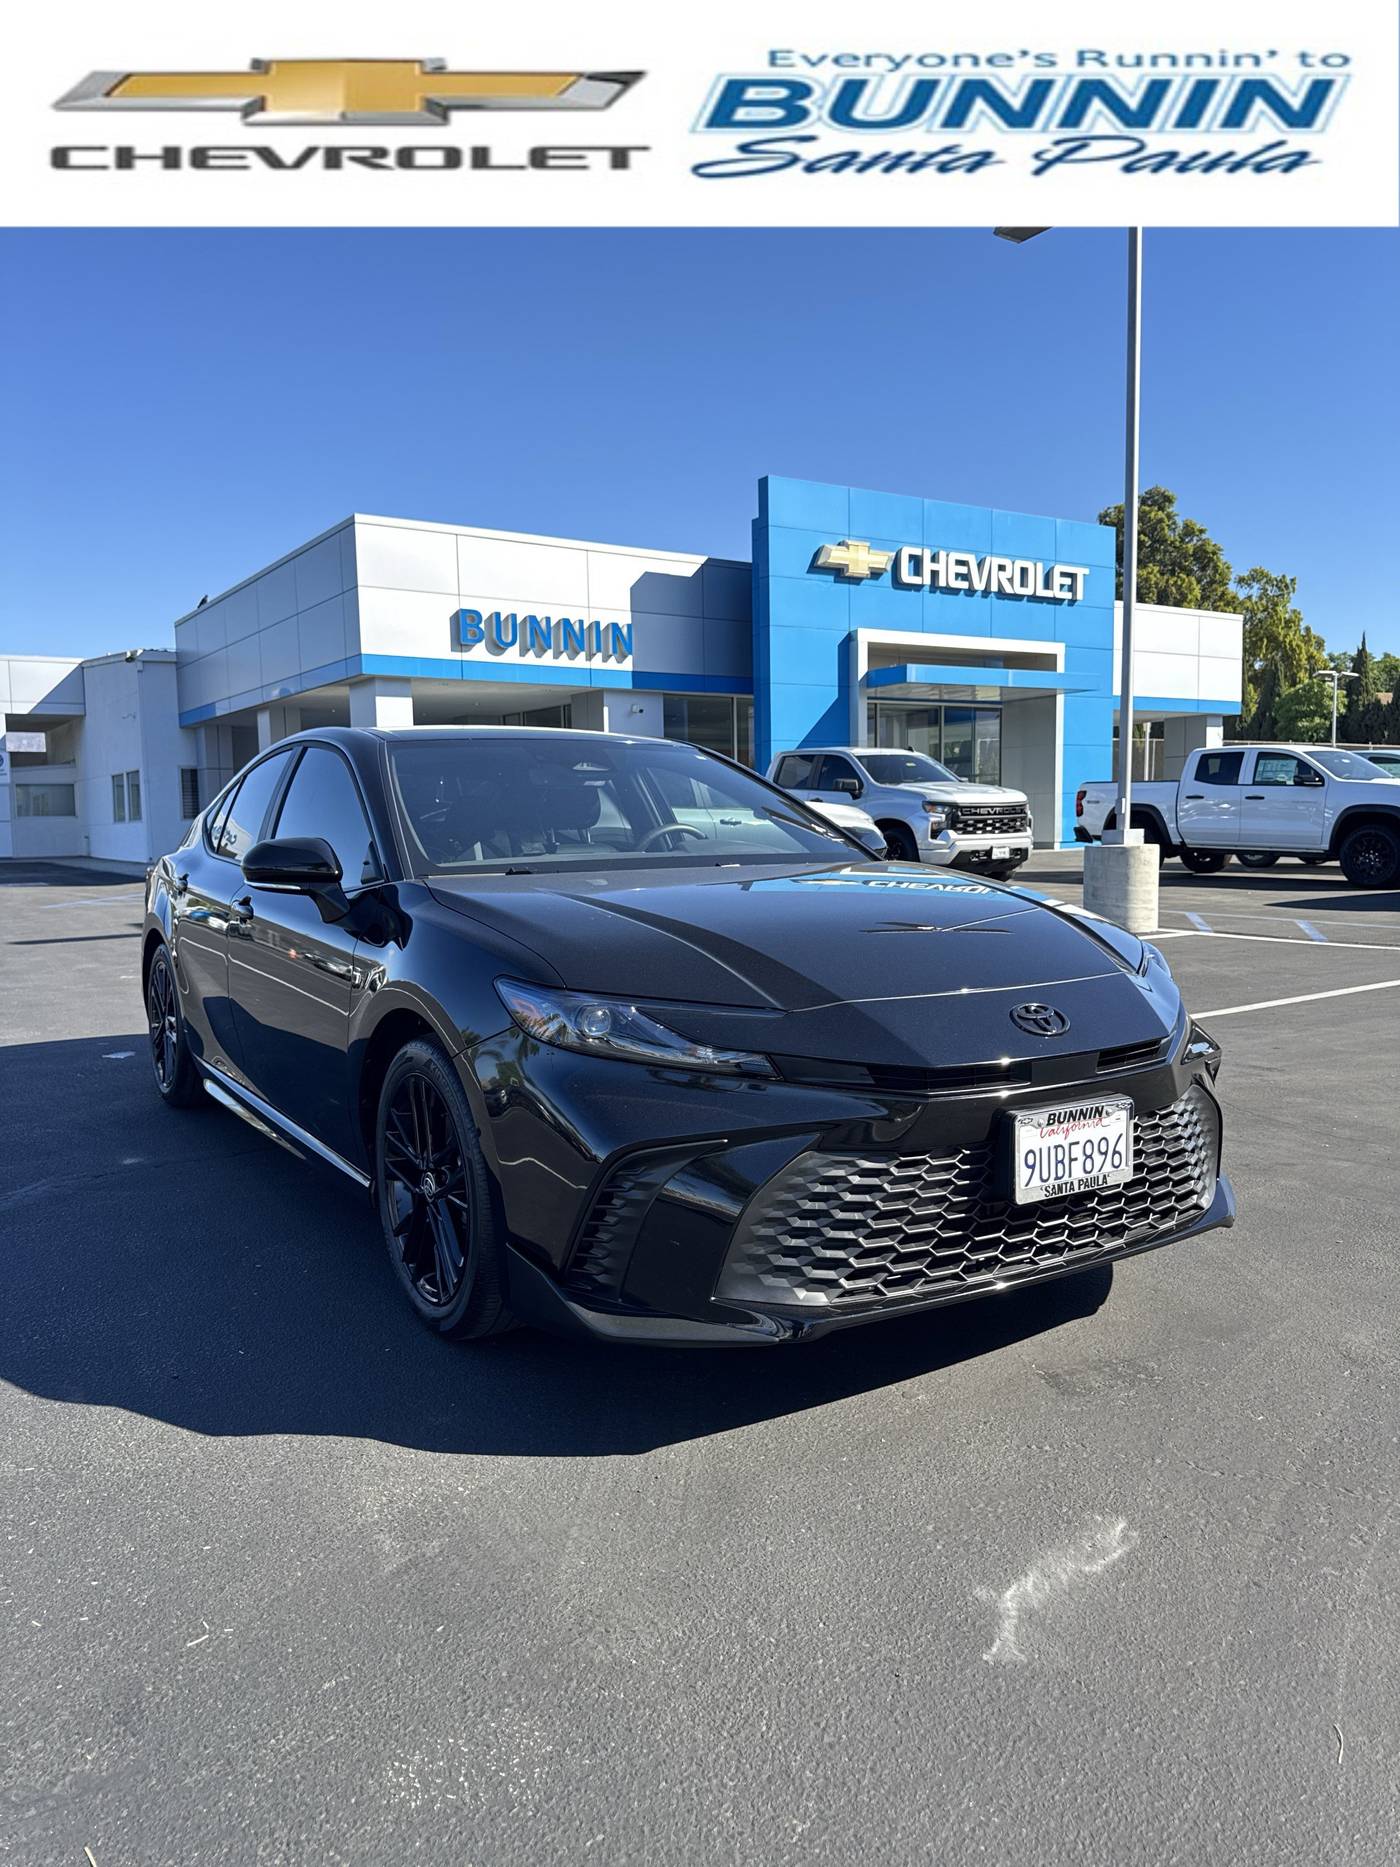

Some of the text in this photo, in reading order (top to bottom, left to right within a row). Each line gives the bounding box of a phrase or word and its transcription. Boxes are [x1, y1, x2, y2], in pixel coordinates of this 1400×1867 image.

[900, 545, 1090, 601] CHEVROLET
[456, 608, 634, 658] BUNNIN
[1046, 1105, 1105, 1126] BUNNIN
[1024, 1133, 1123, 1187] 9UBF896
[1044, 1174, 1108, 1198] SANTA PAULA
